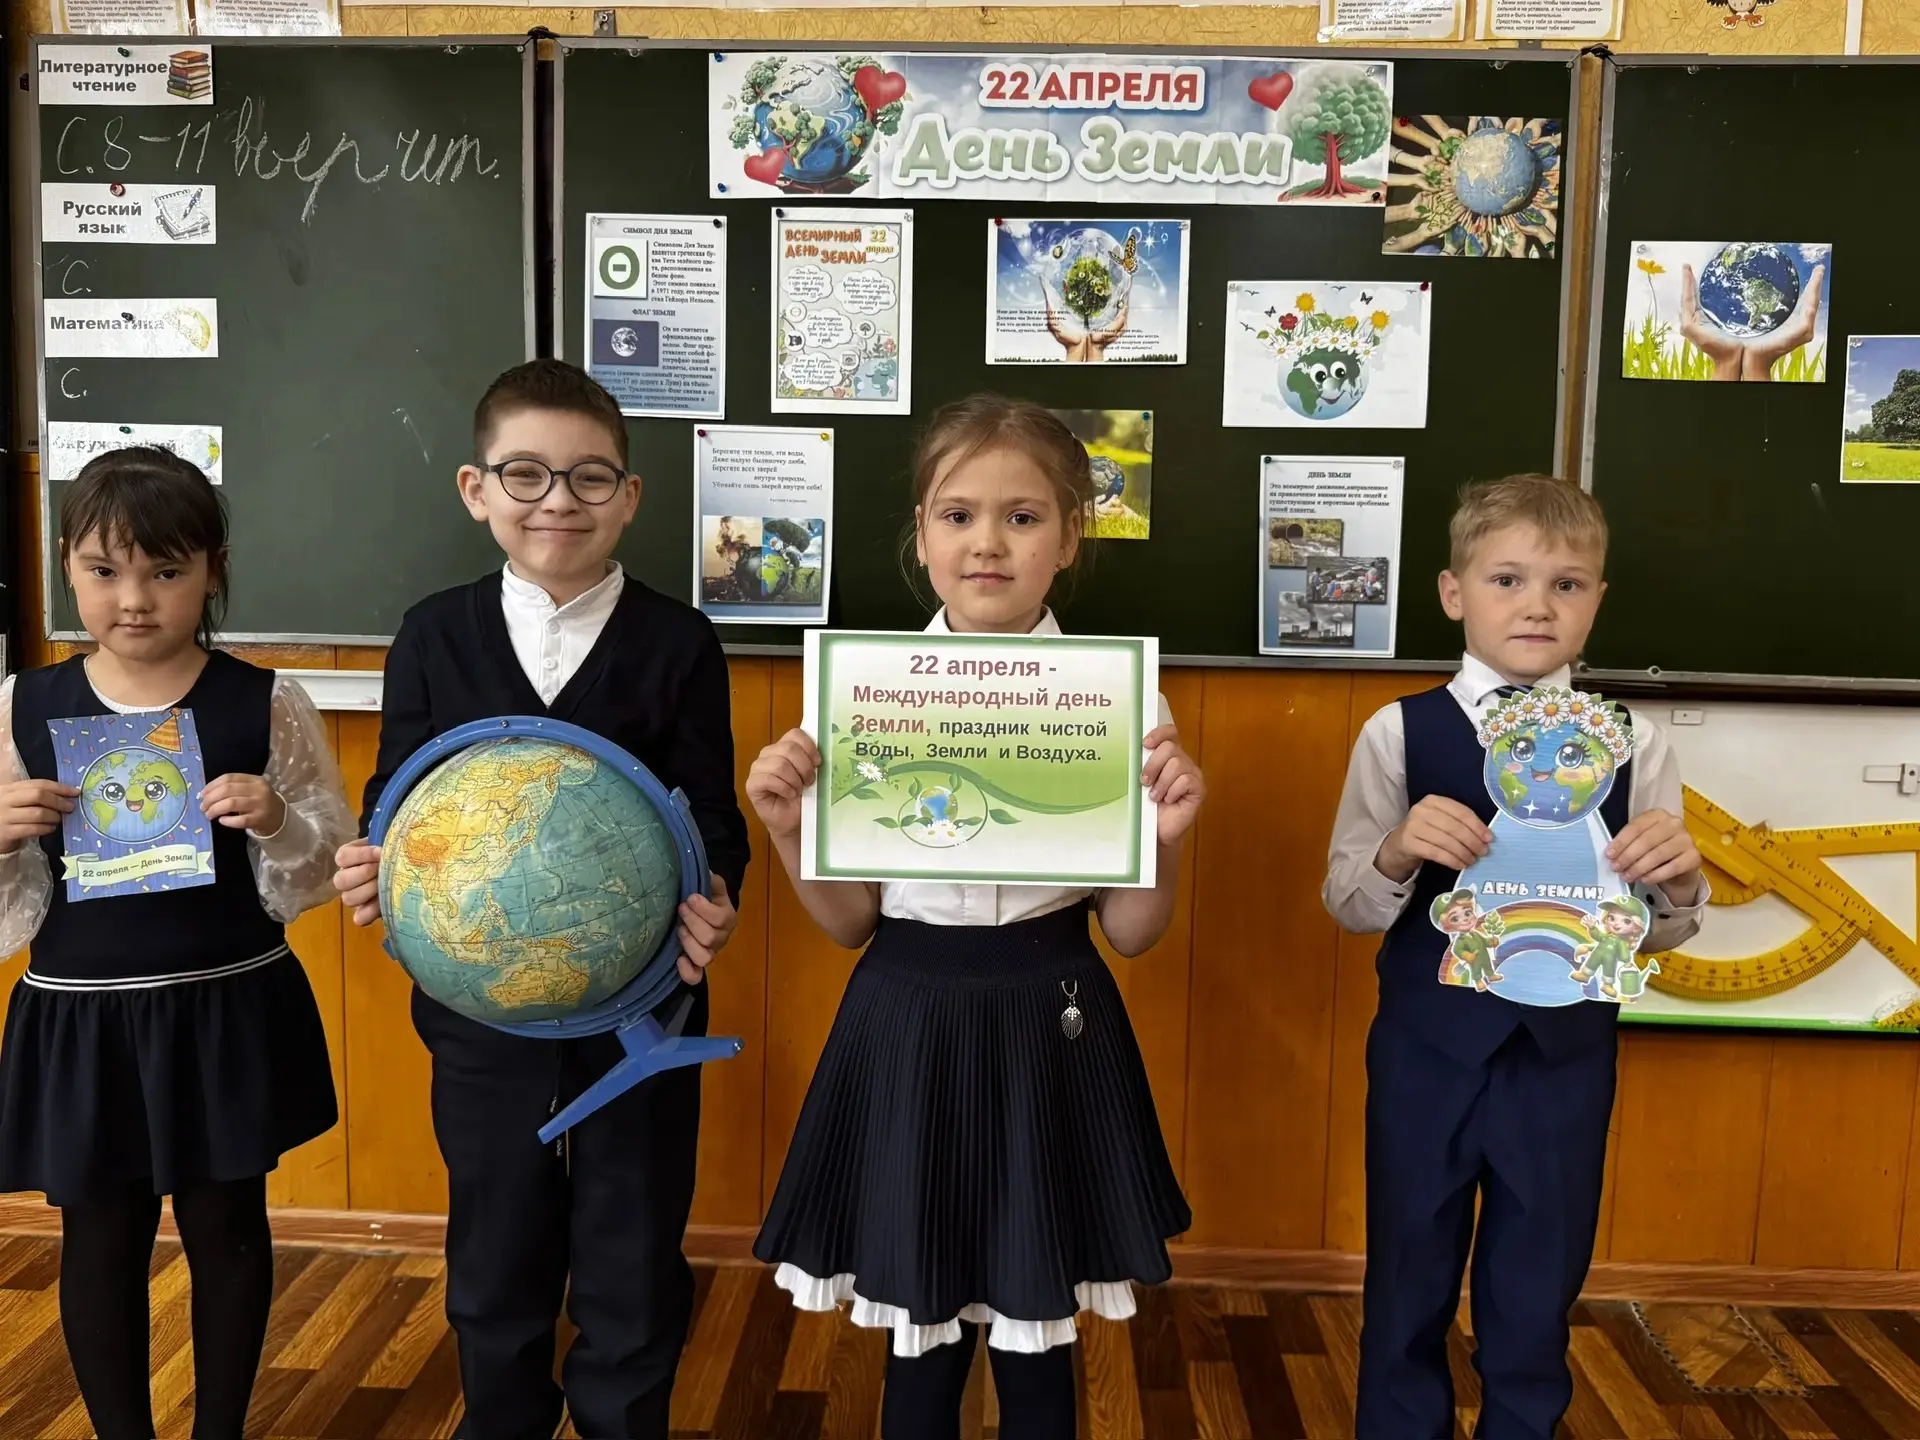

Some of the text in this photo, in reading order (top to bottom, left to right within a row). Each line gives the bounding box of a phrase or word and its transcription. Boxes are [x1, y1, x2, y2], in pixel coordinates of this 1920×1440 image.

[39, 60, 167, 77] Литературное
[73, 81, 137, 91] чтение
[985, 70, 1199, 101] 22 АПРЕЛЯ
[898, 122, 1292, 181] День Земли
[64, 201, 141, 218] Русский
[78, 223, 126, 233] язык
[785, 229, 862, 242] ВСЕМИРНЫЙ
[870, 230, 886, 242] 22
[785, 245, 866, 264] ДЕНЬ ЗЕМЛИ
[753, 457, 786, 465] былиночку
[910, 654, 938, 675] 22
[946, 659, 1040, 681] апреля
[853, 685, 1112, 711] Международный день
[851, 714, 1107, 737] Земли, праздник чистой
[855, 742, 1102, 764] Воды, Земли и Воздуха.
[96, 865, 129, 878] апреля
[141, 858, 162, 869] День
[165, 854, 193, 863] Земли
[1482, 881, 1605, 900] ДЕНЬ ЗЕМЛИ!
